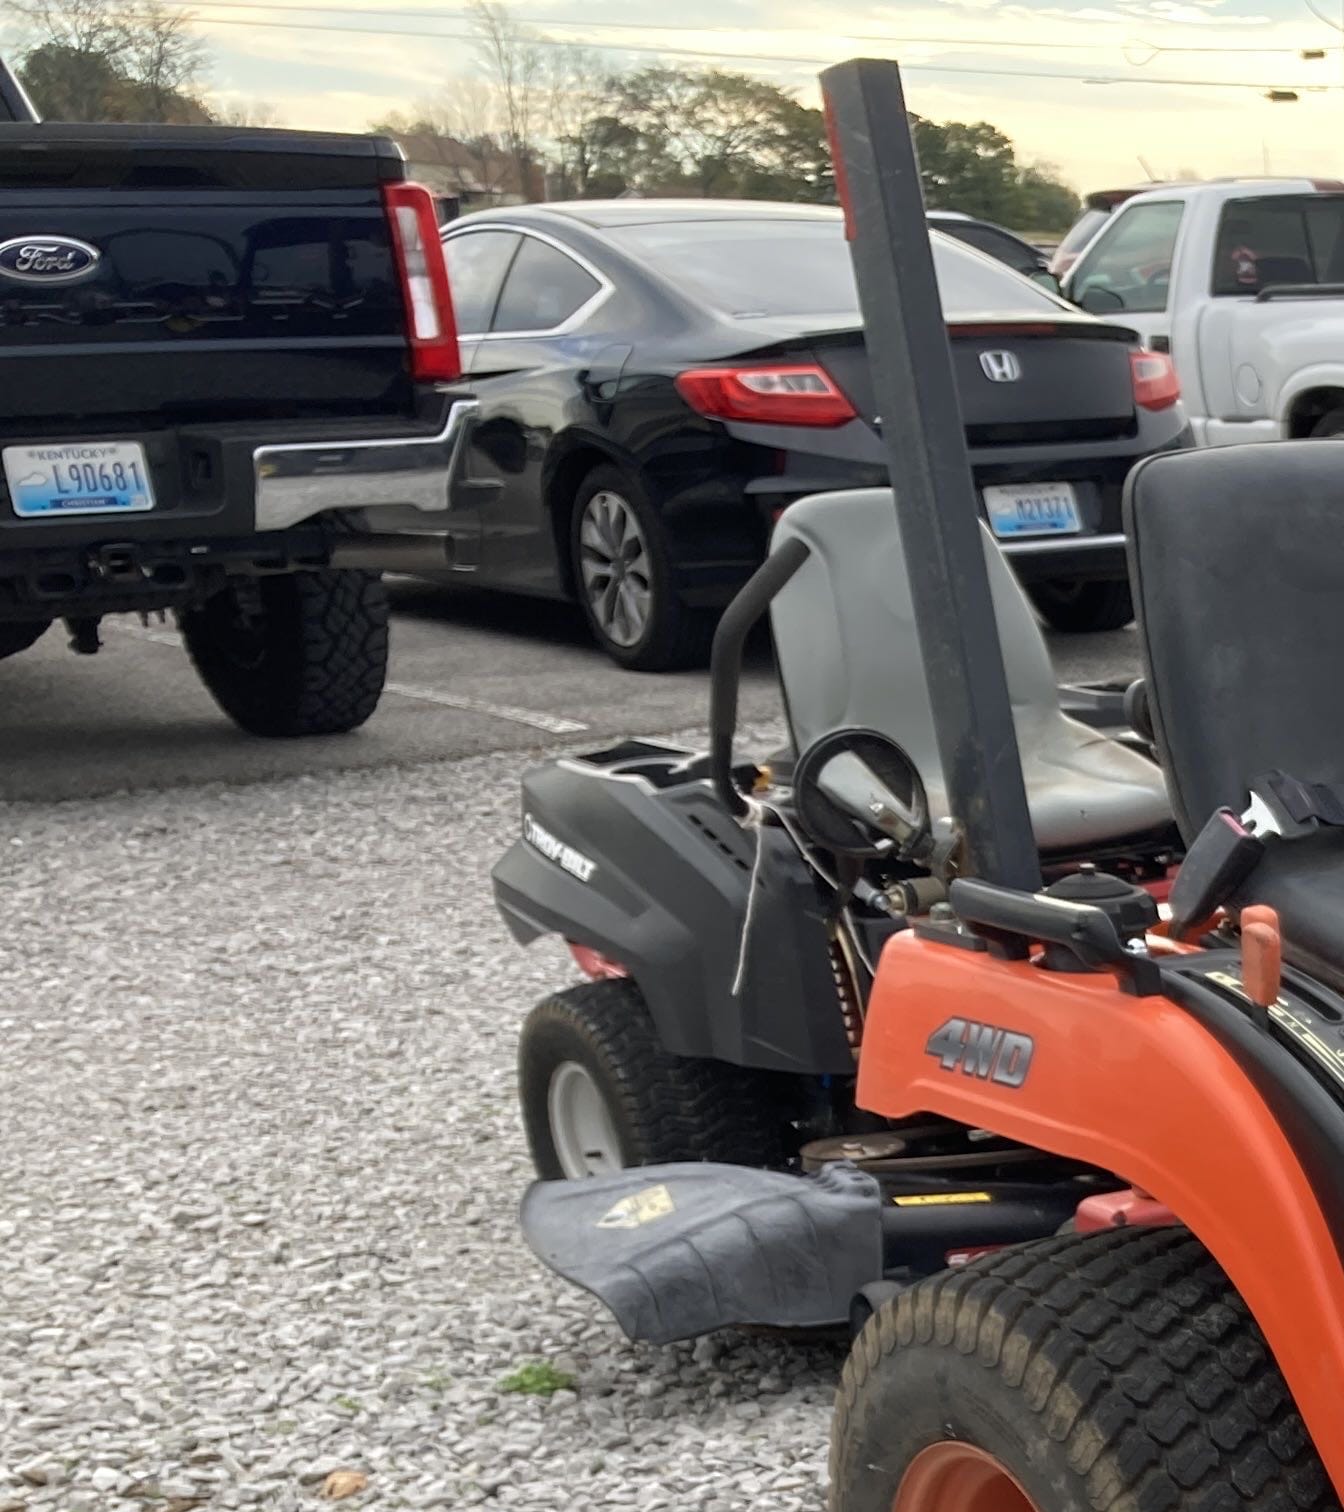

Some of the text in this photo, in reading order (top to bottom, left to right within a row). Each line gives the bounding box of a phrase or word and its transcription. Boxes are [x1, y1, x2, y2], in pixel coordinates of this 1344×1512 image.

[16, 246, 75, 270] Ford
[36, 448, 107, 461] KENTUCKY
[52, 461, 143, 494] L9D681
[924, 1016, 1035, 1089] 4WD
